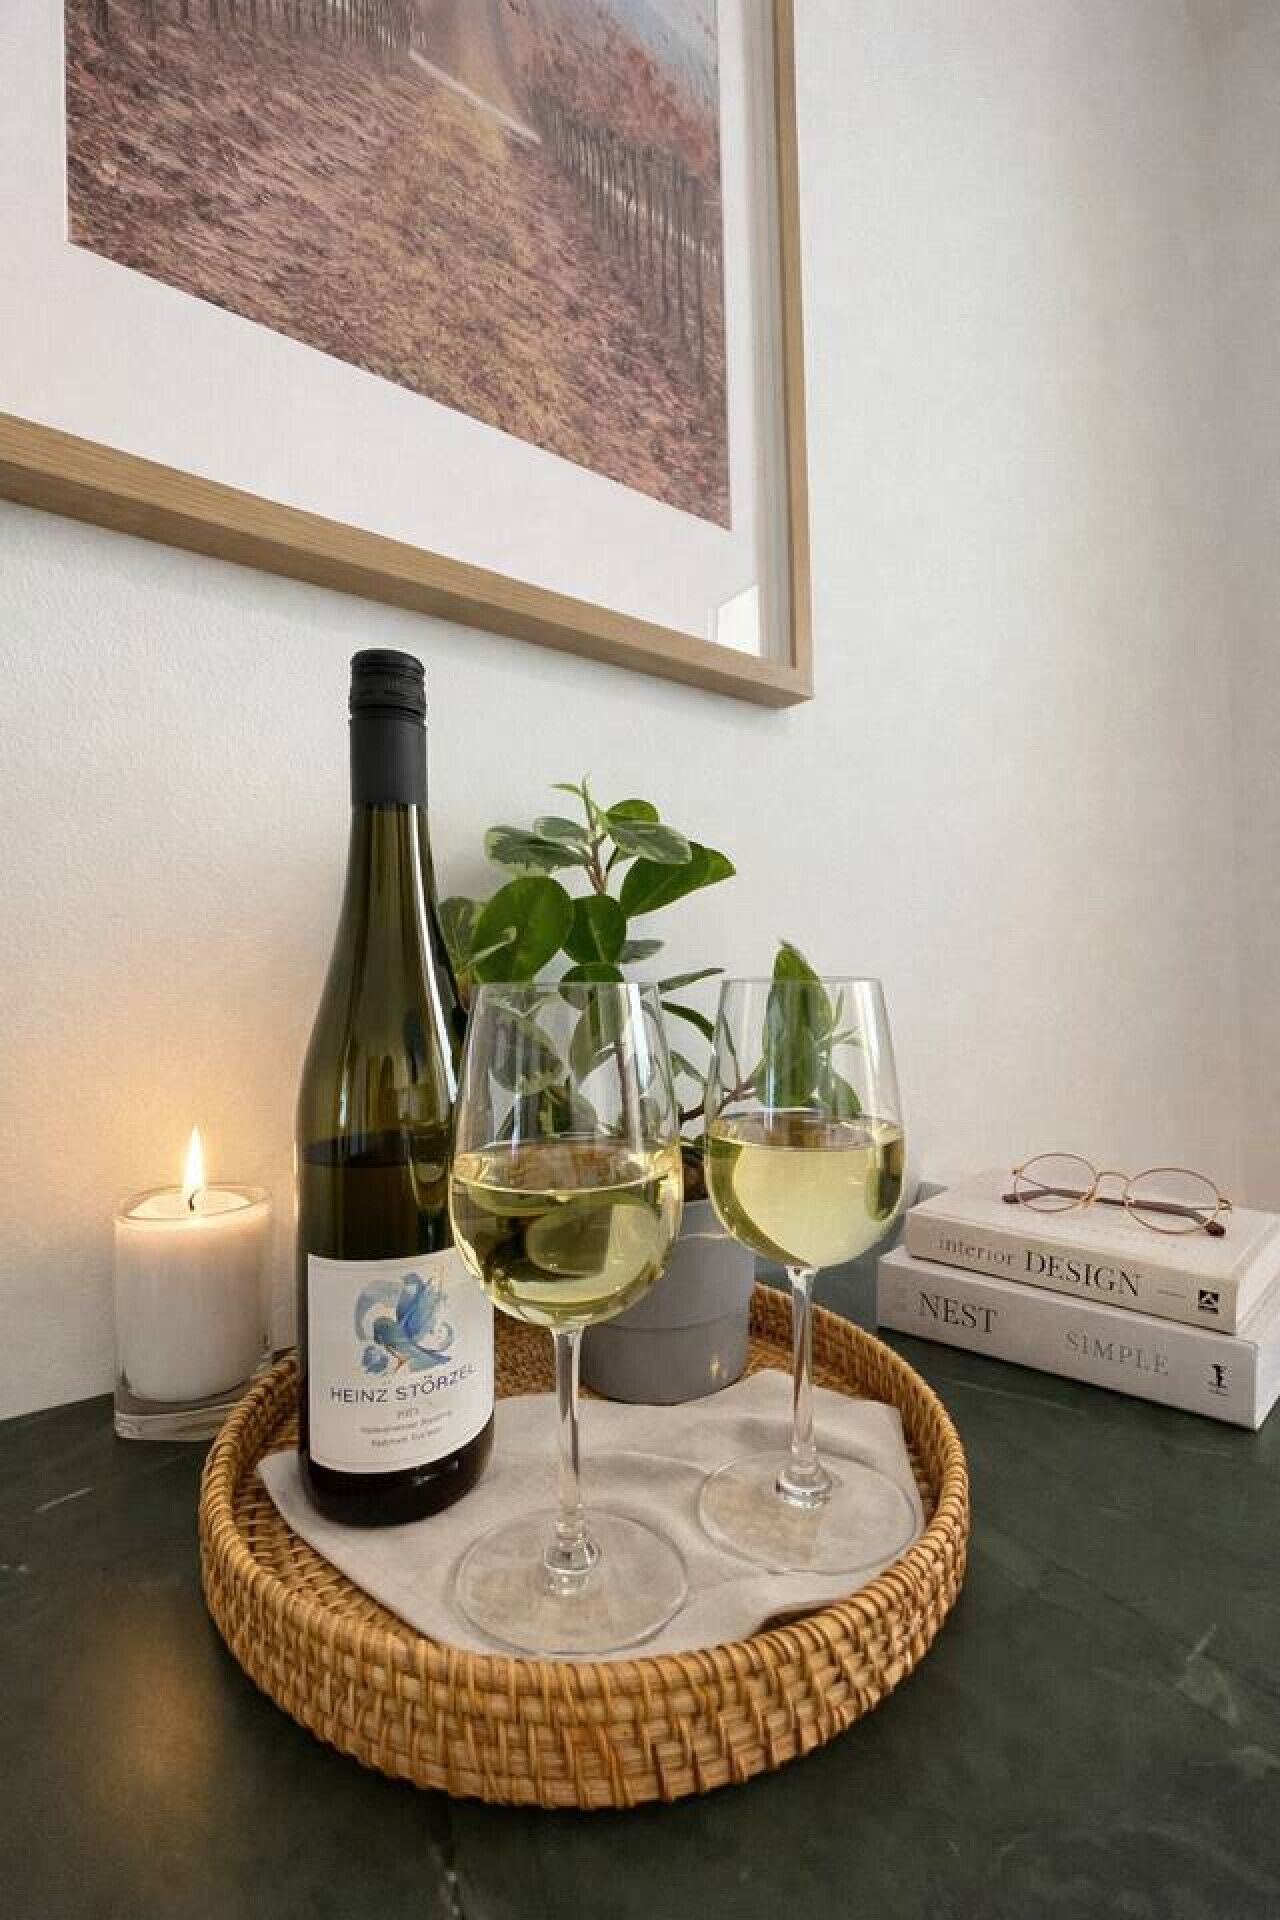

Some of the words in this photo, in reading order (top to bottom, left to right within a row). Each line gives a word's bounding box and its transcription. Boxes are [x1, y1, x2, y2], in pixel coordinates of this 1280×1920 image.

[938, 1231, 1015, 1266] interior
[1023, 1250, 1140, 1297] DESIGN
[918, 1291, 998, 1333] NEST
[1065, 1331, 1168, 1376] SIMPLE
[330, 1387, 387, 1402] HEINZ
